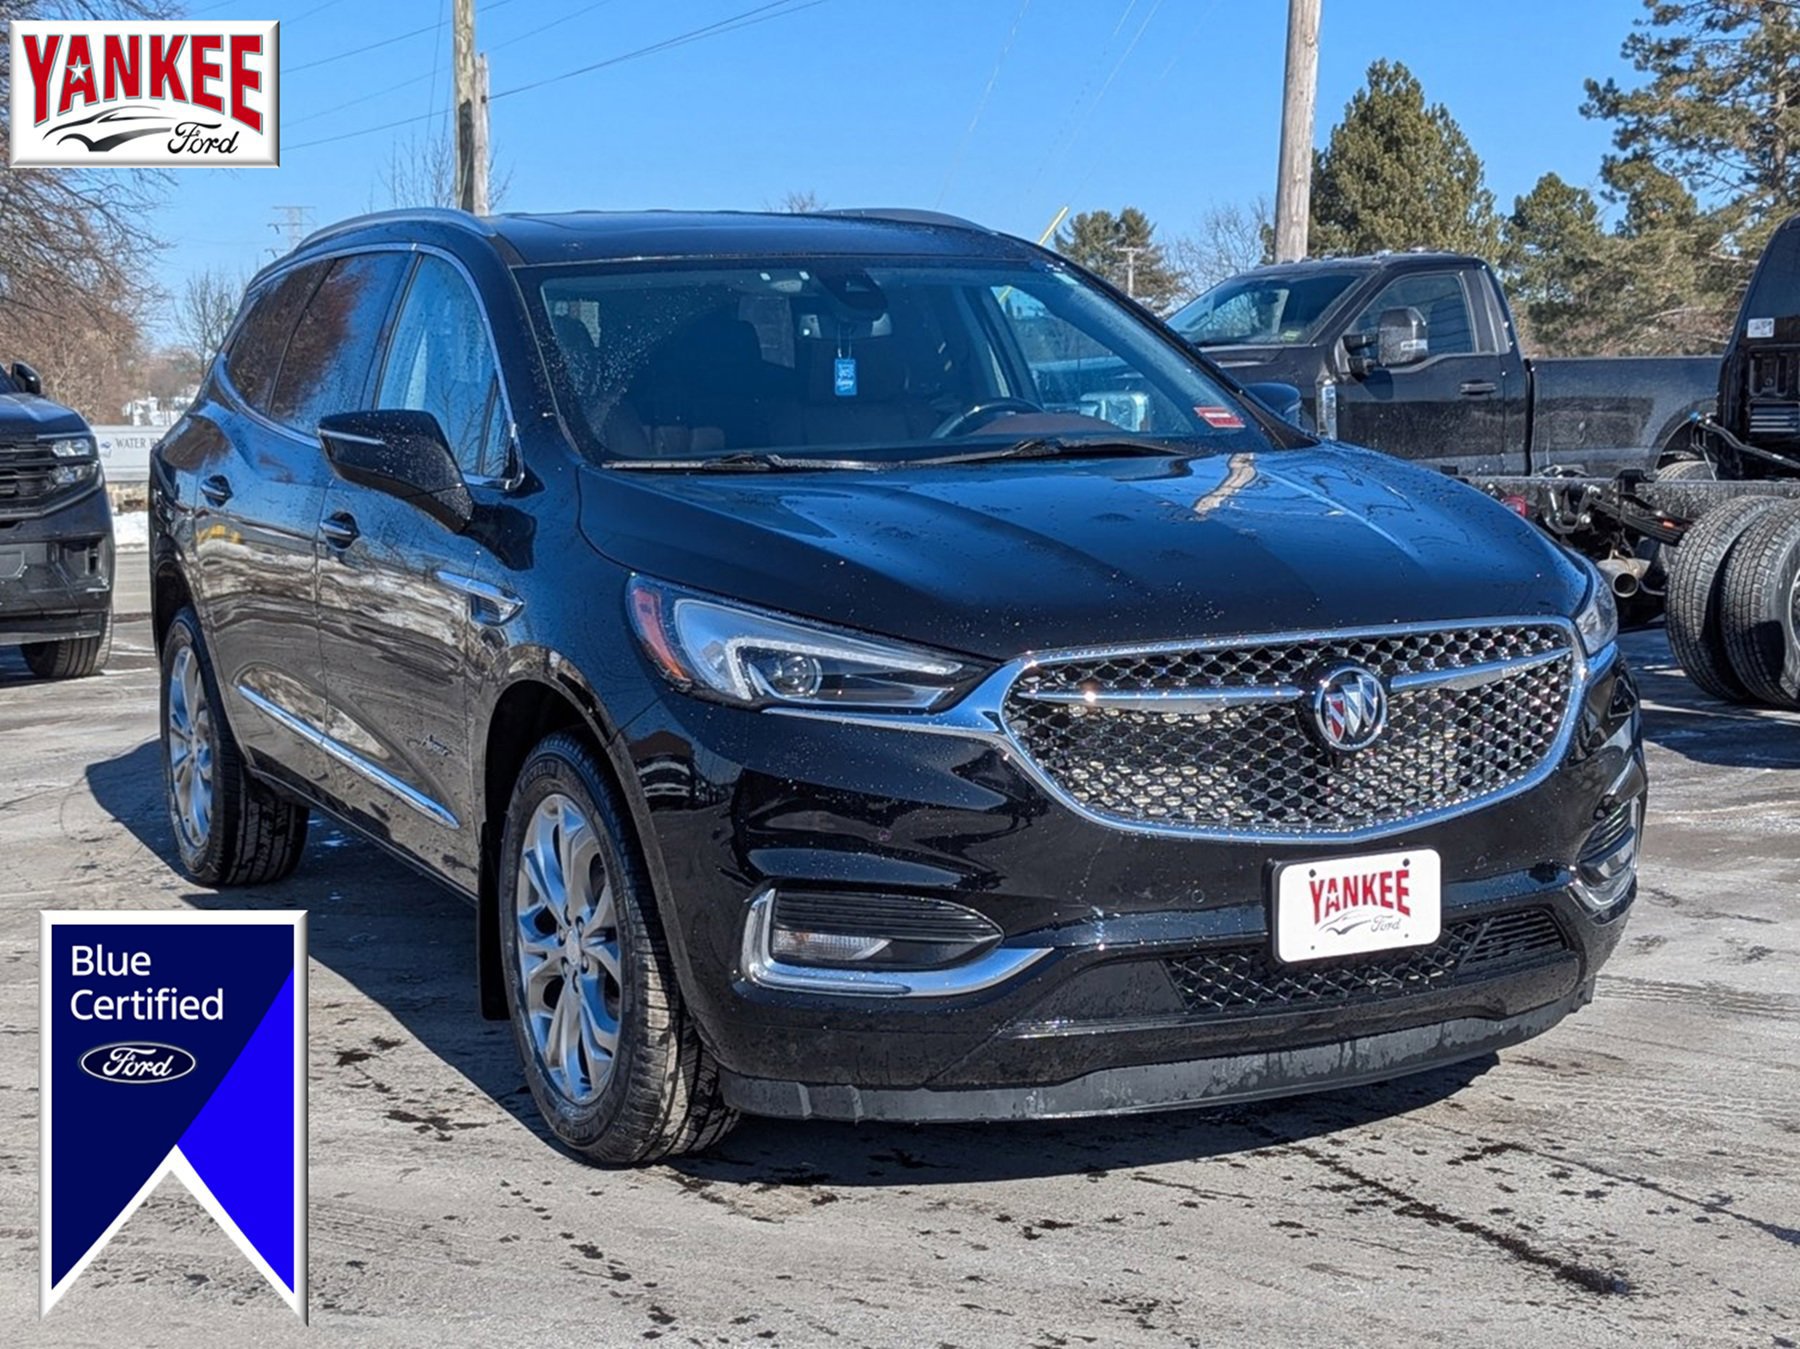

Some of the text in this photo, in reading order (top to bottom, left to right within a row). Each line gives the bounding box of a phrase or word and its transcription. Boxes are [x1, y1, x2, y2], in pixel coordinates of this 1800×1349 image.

[114, 437, 147, 449] WATER
[1308, 868, 1411, 926] YANKEE
[1370, 914, 1402, 933] Ford
